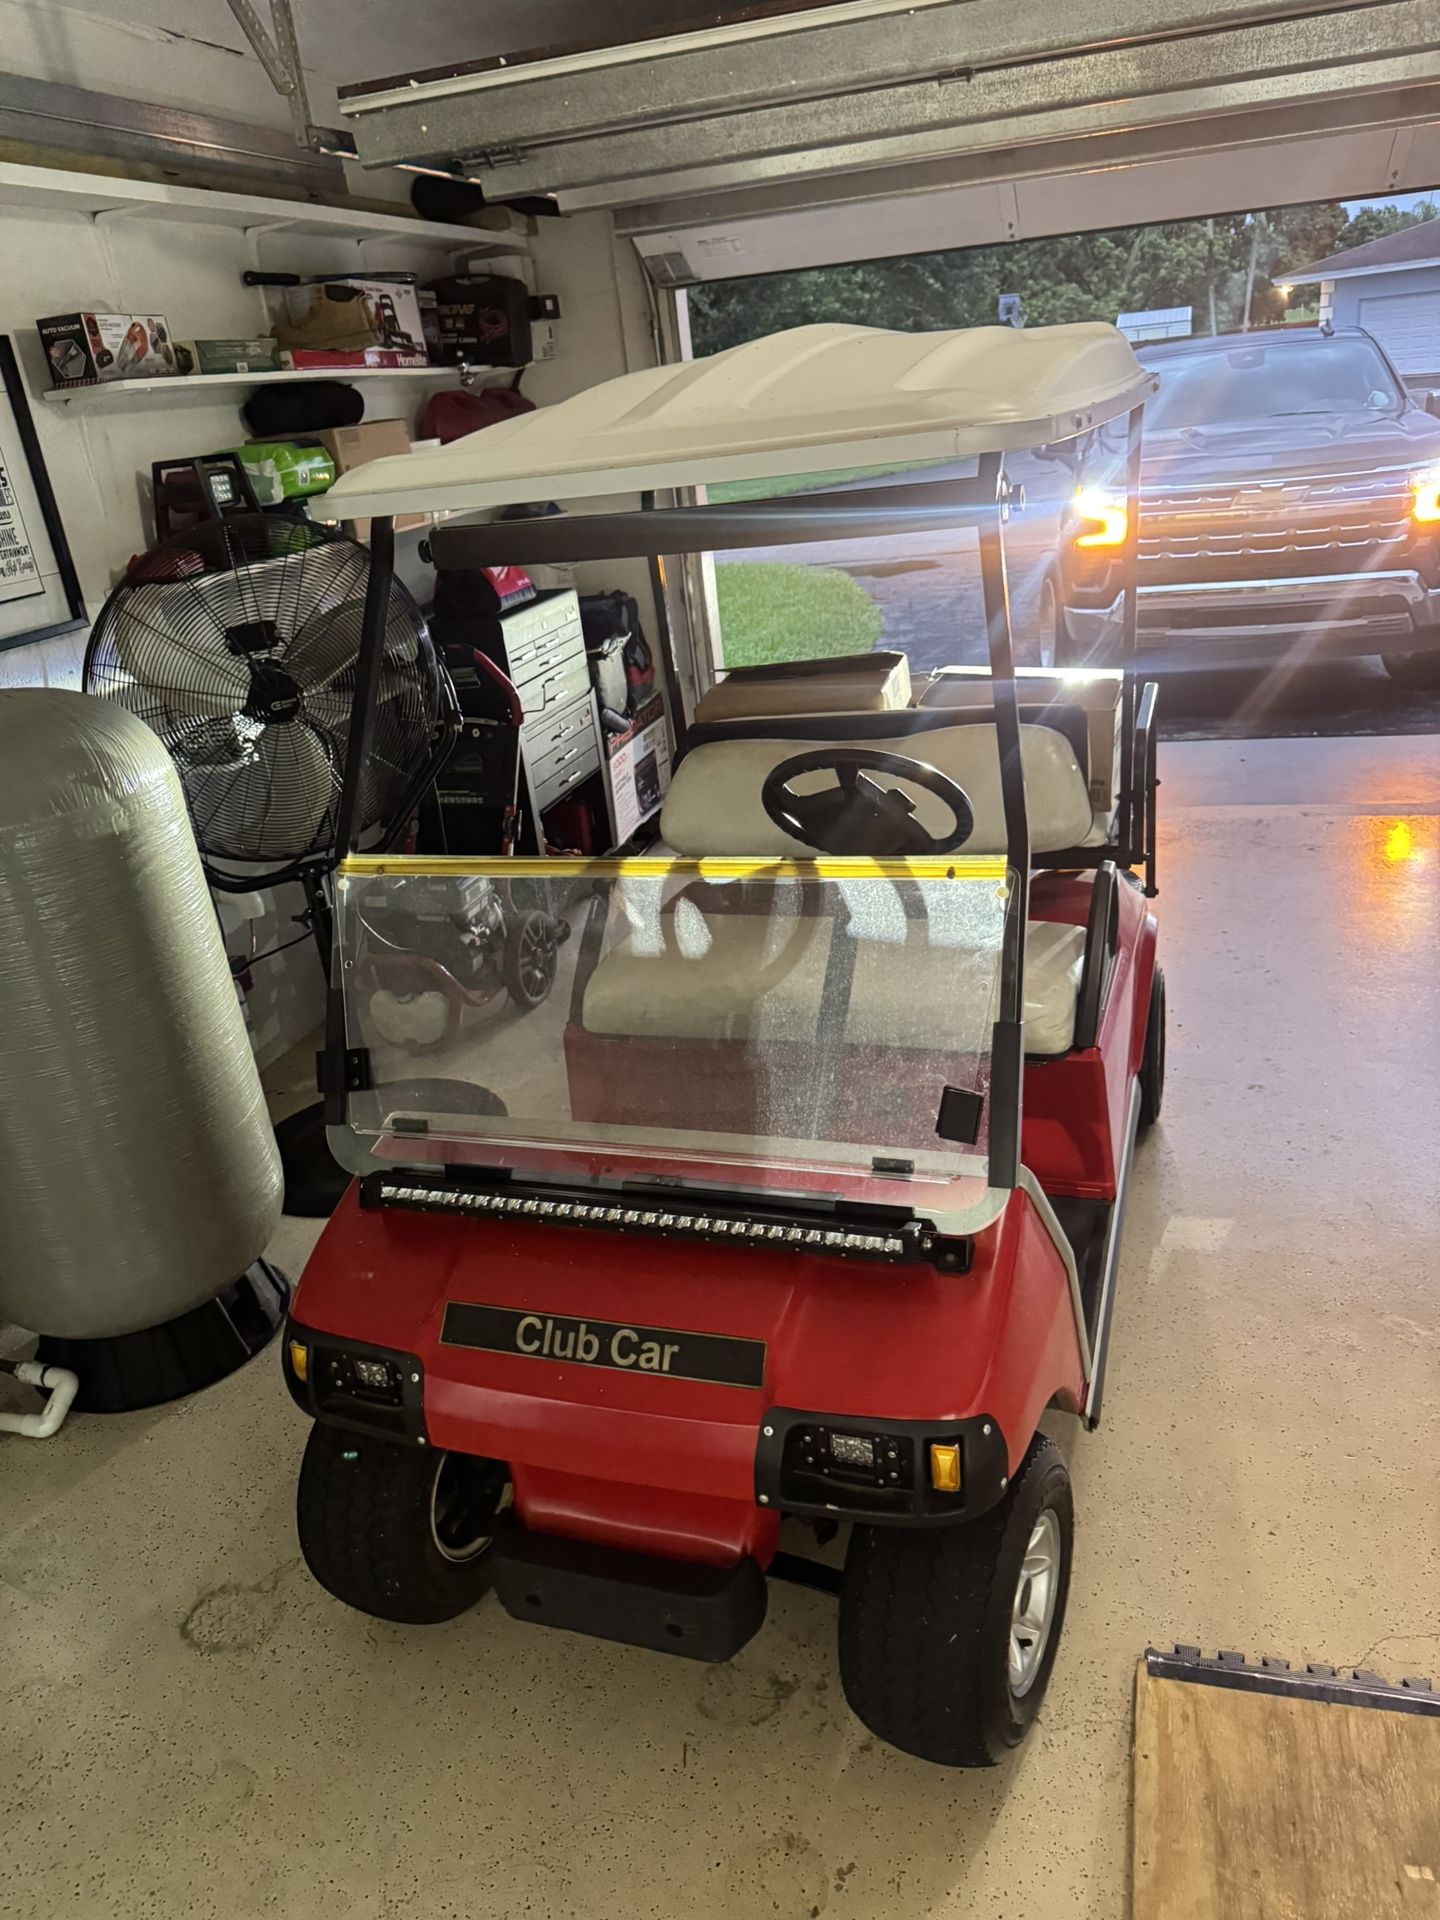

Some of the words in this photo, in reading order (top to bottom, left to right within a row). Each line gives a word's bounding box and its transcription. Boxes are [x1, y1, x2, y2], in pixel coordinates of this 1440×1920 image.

[42, 326, 57, 335] AUTO
[57, 322, 81, 333] VACUUM
[396, 354, 428, 367] Homelite
[515, 1315, 600, 1362] Club
[610, 1328, 681, 1372] Car
